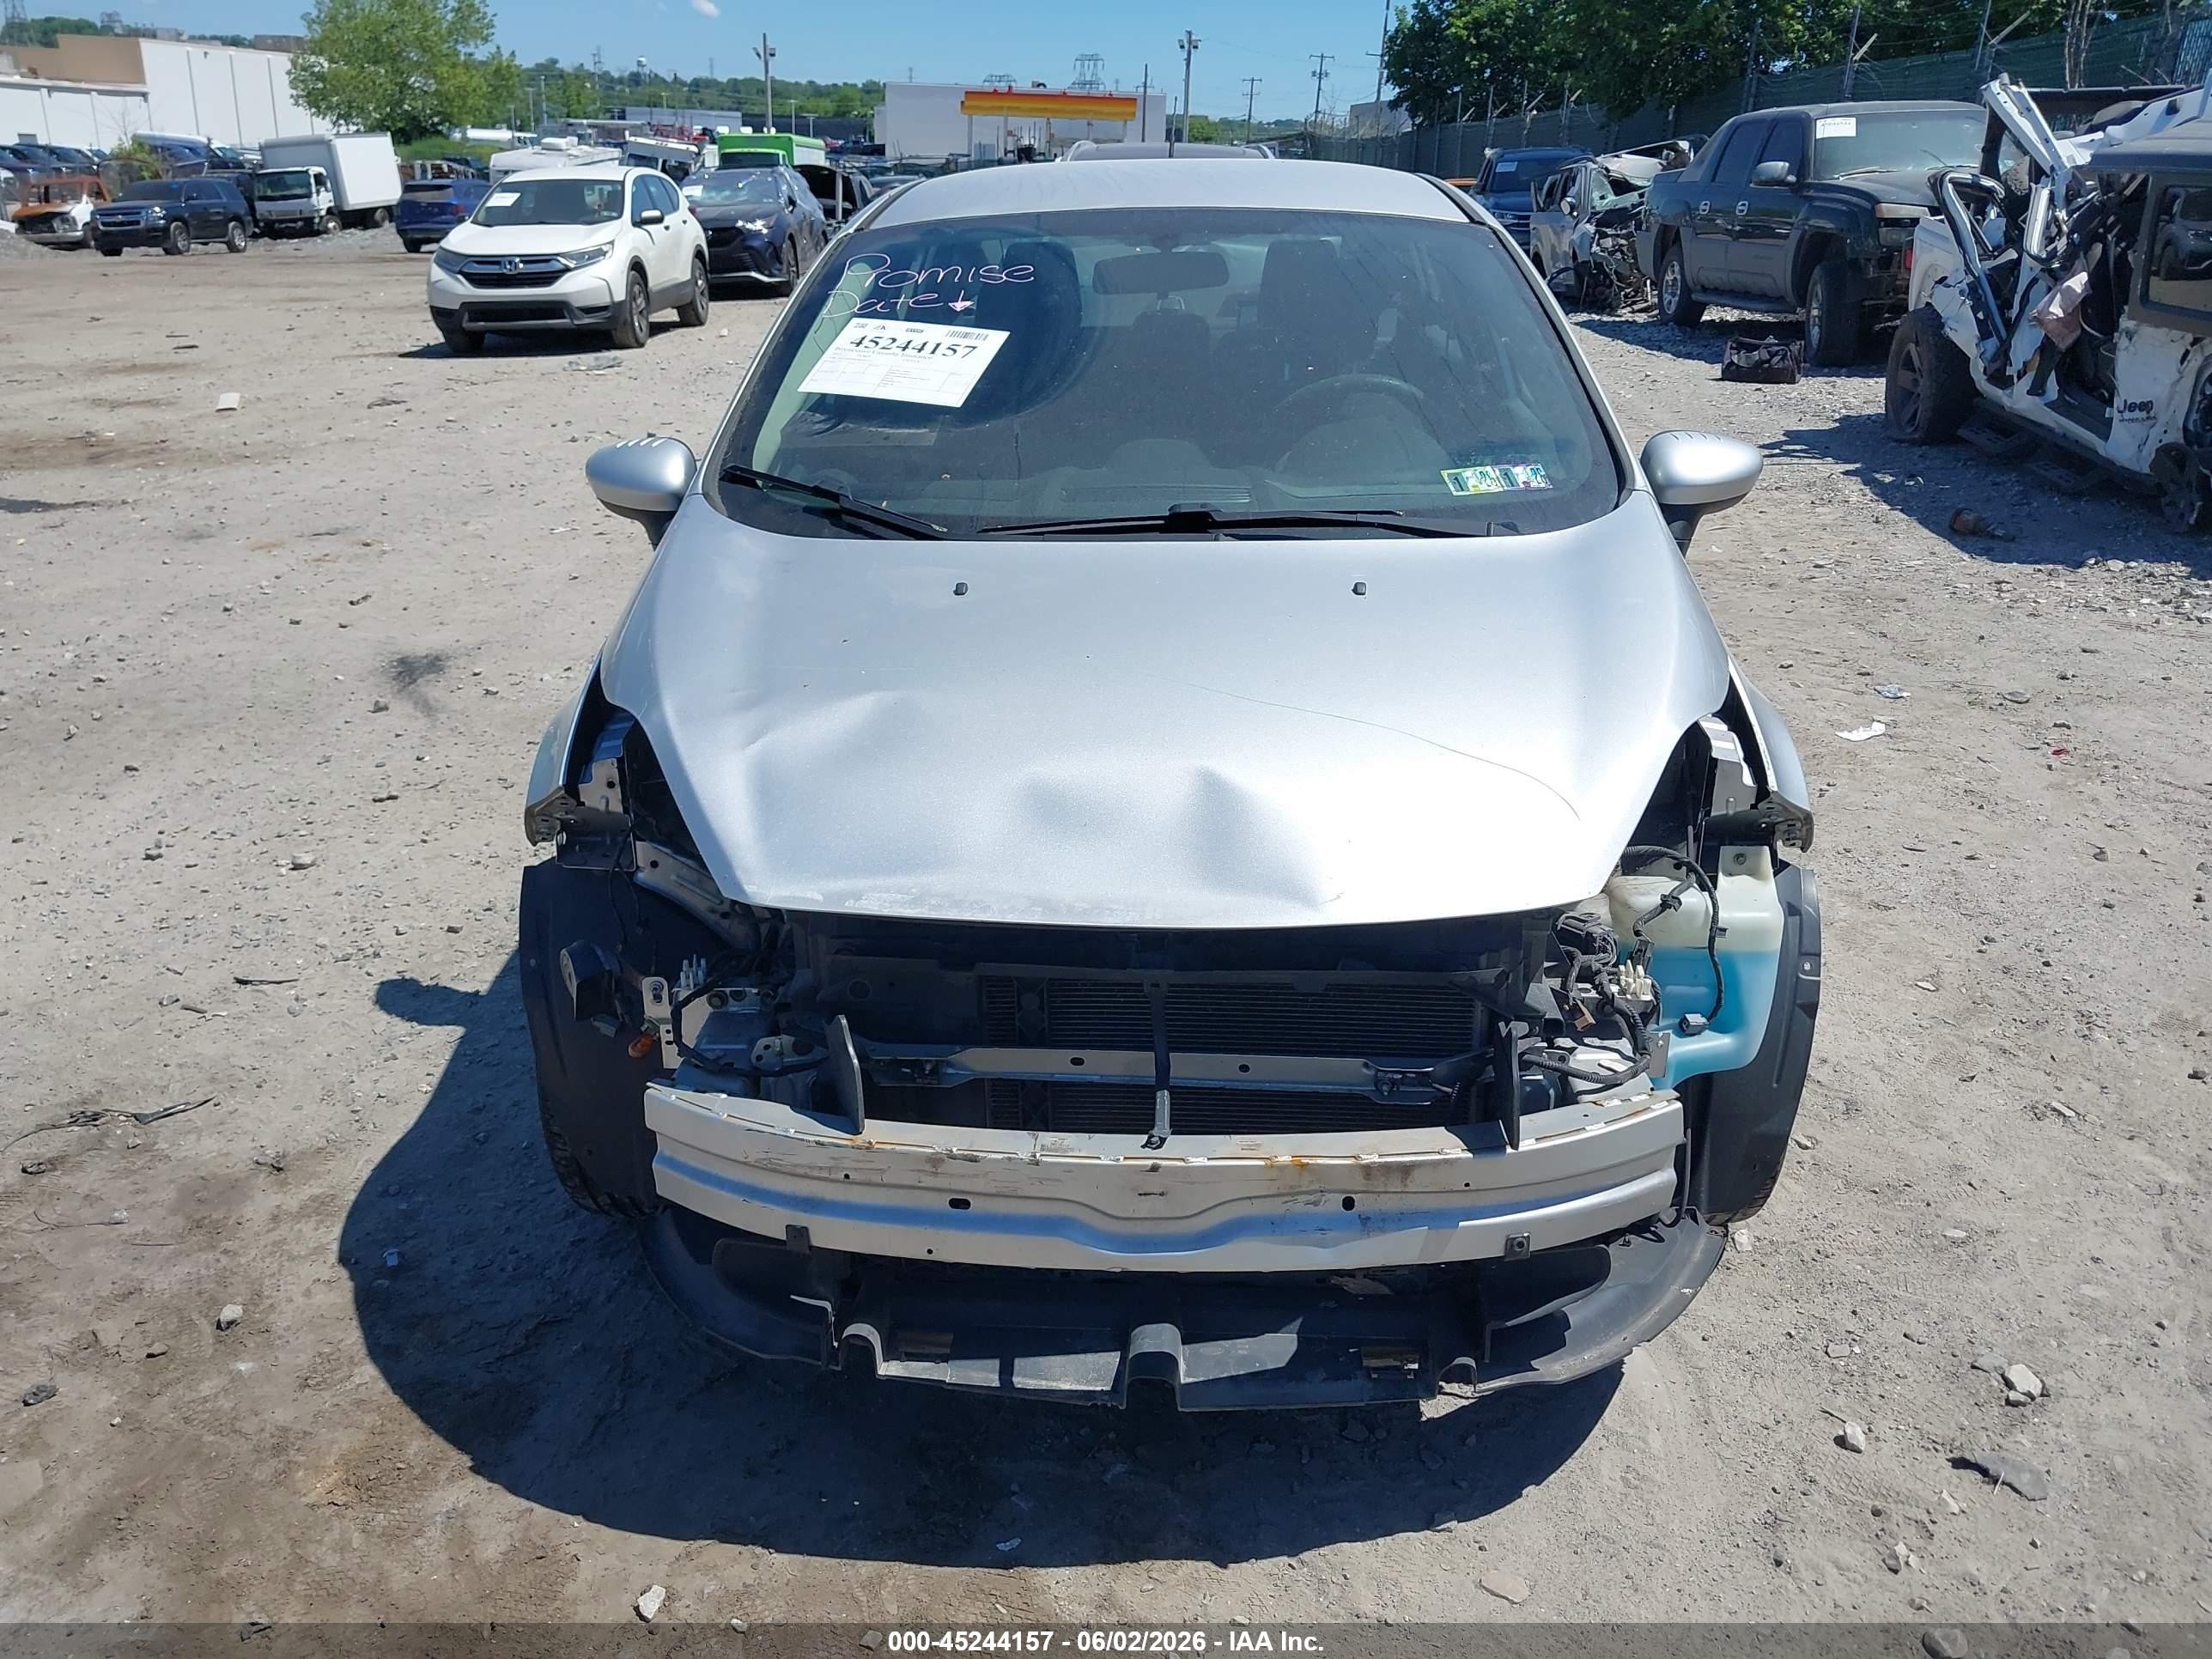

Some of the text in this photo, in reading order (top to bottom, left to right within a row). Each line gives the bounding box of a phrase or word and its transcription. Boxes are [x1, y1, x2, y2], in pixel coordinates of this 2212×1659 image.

[836, 252, 1036, 292] Promise
[823, 289, 944, 319] Date
[849, 334, 979, 359] 45244157
[2117, 398, 2154, 414] Jeep
